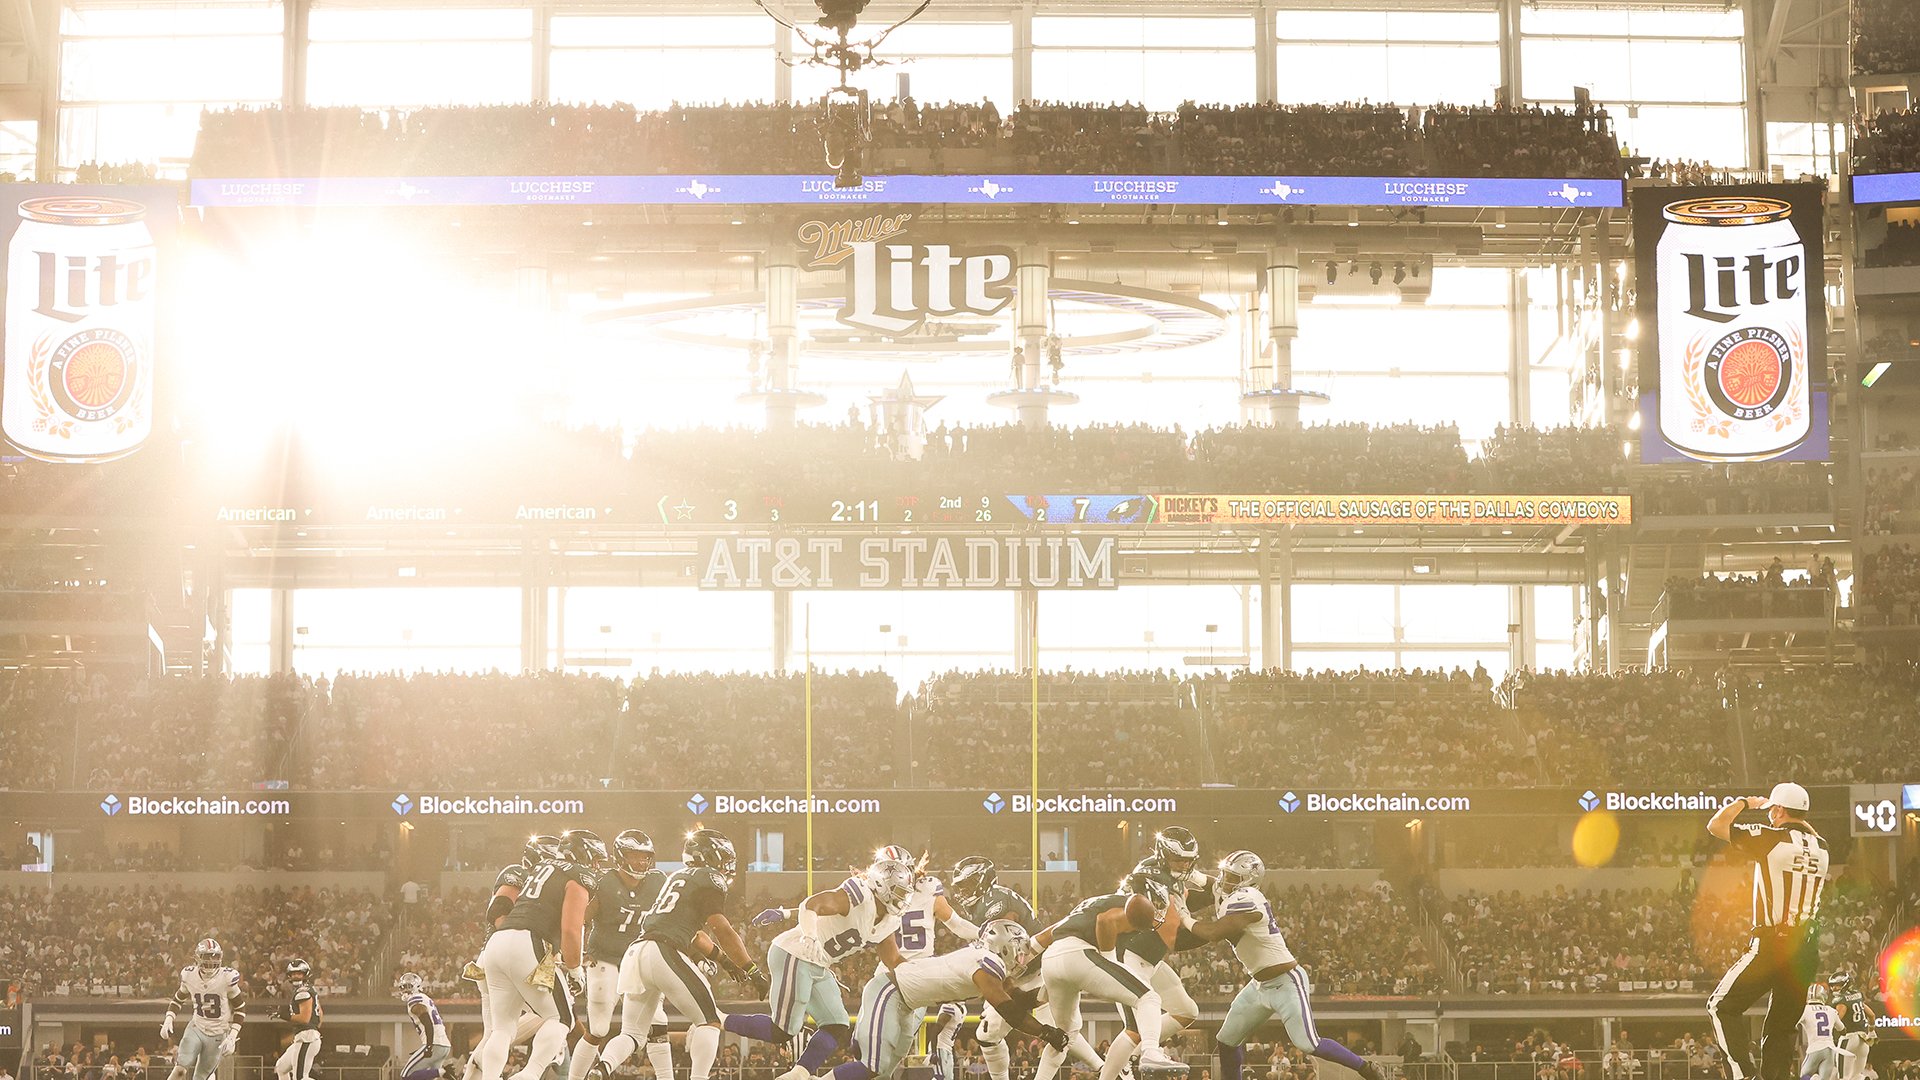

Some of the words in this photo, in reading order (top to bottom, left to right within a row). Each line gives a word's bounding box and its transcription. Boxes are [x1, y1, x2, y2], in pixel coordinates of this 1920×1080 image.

[221, 184, 303, 196] LUCCHESE
[510, 182, 592, 194] LUCCHESE
[1094, 181, 1176, 193] LUCCHESE
[1385, 183, 1466, 195] LUCCHESE
[798, 213, 912, 260] Miller
[31, 250, 150, 323] Lite
[843, 241, 1011, 331] Lite
[1680, 252, 1800, 323] Lite
[57, 331, 90, 358] FINE
[1707, 360, 1719, 371] A
[1713, 330, 1744, 358] FINE
[1747, 328, 1790, 363] PILSNER
[75, 407, 116, 420] BEER
[1733, 403, 1773, 419] BEER
[724, 500, 738, 520] 3
[831, 500, 879, 521] 2:11
[939, 496, 961, 508] 2nd
[981, 496, 990, 508] 9
[1075, 499, 1090, 520] 7
[1165, 498, 1218, 512] DICKEY'S
[1229, 501, 1260, 517] THE
[1265, 501, 1336, 517] OFFICIAL
[1339, 501, 1411, 518] SAUSAGE
[1415, 501, 1436, 518] OF
[1440, 501, 1470, 517] THE
[1475, 501, 1535, 518] DALLAS
[1538, 501, 1619, 518] COWBOYS
[216, 506, 296, 520] American
[366, 505, 446, 520] American
[515, 504, 596, 520] American
[770, 509, 780, 521] 3
[904, 510, 912, 521] 2
[975, 509, 992, 521] 26
[1037, 509, 1045, 521] 2
[701, 537, 842, 588] AT&T
[859, 537, 1115, 588] STADIUM
[128, 795, 290, 815] Blockchain.com
[419, 795, 584, 814] Blockchain.com
[715, 794, 880, 813] Blockchain.com
[1011, 793, 1177, 812] Blockchain.com
[1307, 792, 1470, 811] Blockchain.com
[1606, 791, 1748, 810] Blockchain.c
[1856, 800, 1897, 832] 40
[1793, 855, 1819, 874] 55
[193, 993, 222, 1019] 13
[1815, 1012, 1830, 1036] 2
